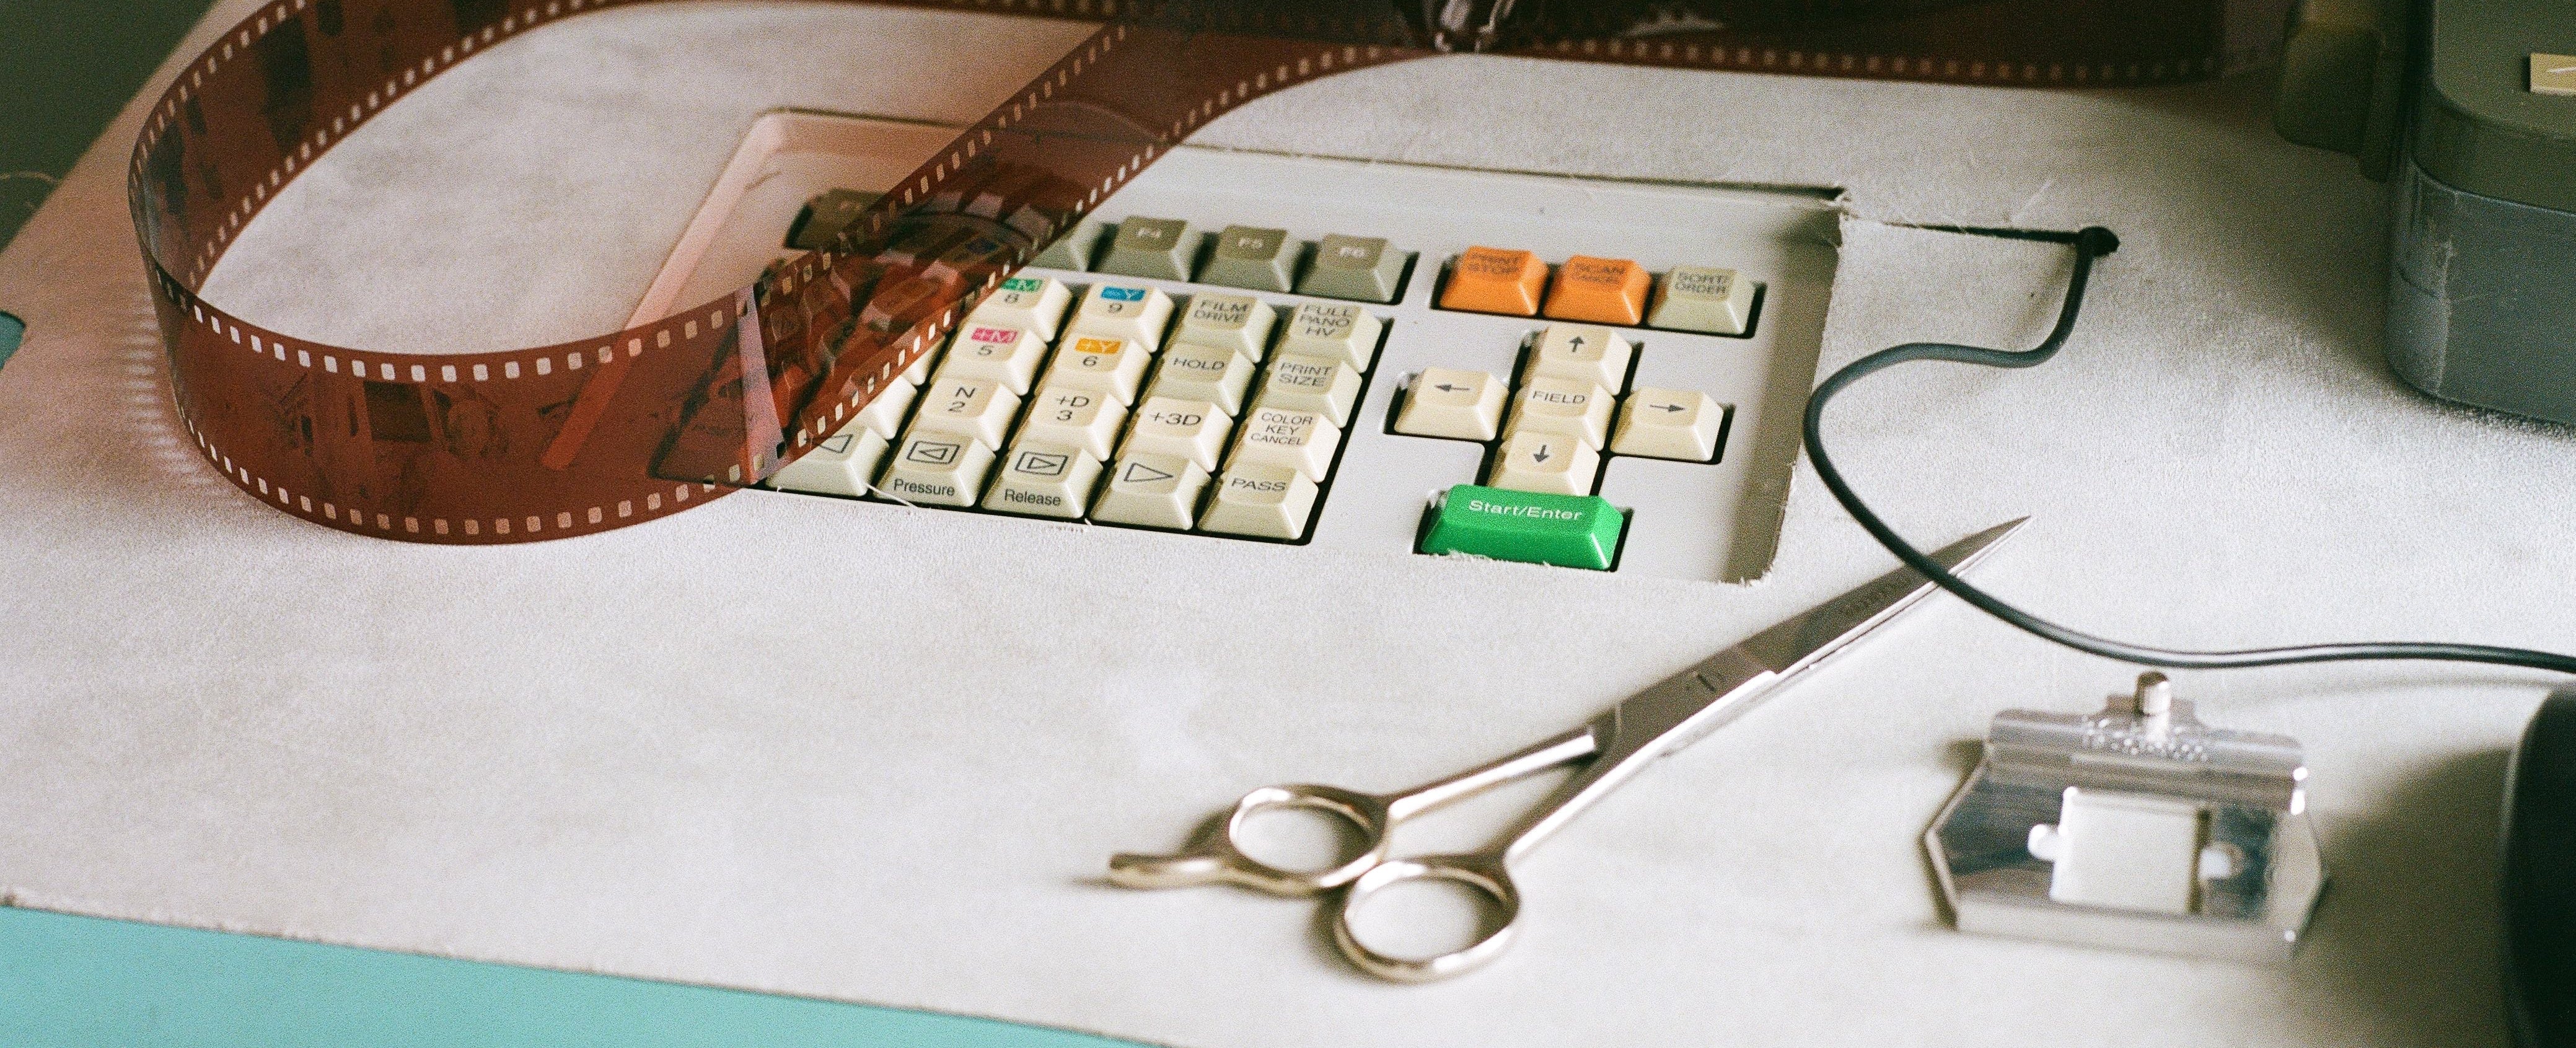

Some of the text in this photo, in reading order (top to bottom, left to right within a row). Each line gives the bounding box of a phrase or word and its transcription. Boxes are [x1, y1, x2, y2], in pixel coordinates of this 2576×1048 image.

[1136, 227, 1162, 239] F4
[1237, 237, 1264, 249] F5
[1339, 247, 1365, 259] F6
[1674, 281, 1726, 294] ORDER
[1004, 293, 1019, 304] 8
[1200, 298, 1249, 313] FILM
[1108, 302, 1123, 314] 9
[1304, 302, 1351, 317] FULL
[1193, 308, 1246, 324] DRIVE
[1299, 314, 1350, 328] PANO
[1306, 325, 1337, 337] HV
[977, 345, 994, 357] 5
[1082, 355, 1098, 368] 6
[1172, 356, 1225, 371] HOLD
[1278, 362, 1332, 376] PRINT
[1277, 374, 1326, 387] SIZE
[954, 385, 977, 399] N
[1532, 389, 1586, 405] FIELD
[947, 401, 965, 413] 2
[1055, 395, 1090, 408] +D
[1056, 410, 1073, 421] 3
[1150, 412, 1202, 427] +3D
[1261, 411, 1314, 426] COLOR
[1265, 425, 1300, 436] KEY
[1249, 433, 1305, 447] CANCEL
[893, 478, 956, 496] Pressure
[1231, 477, 1286, 492] PASS
[1003, 488, 1062, 507] Release
[1468, 499, 1583, 522] Start/Enter
